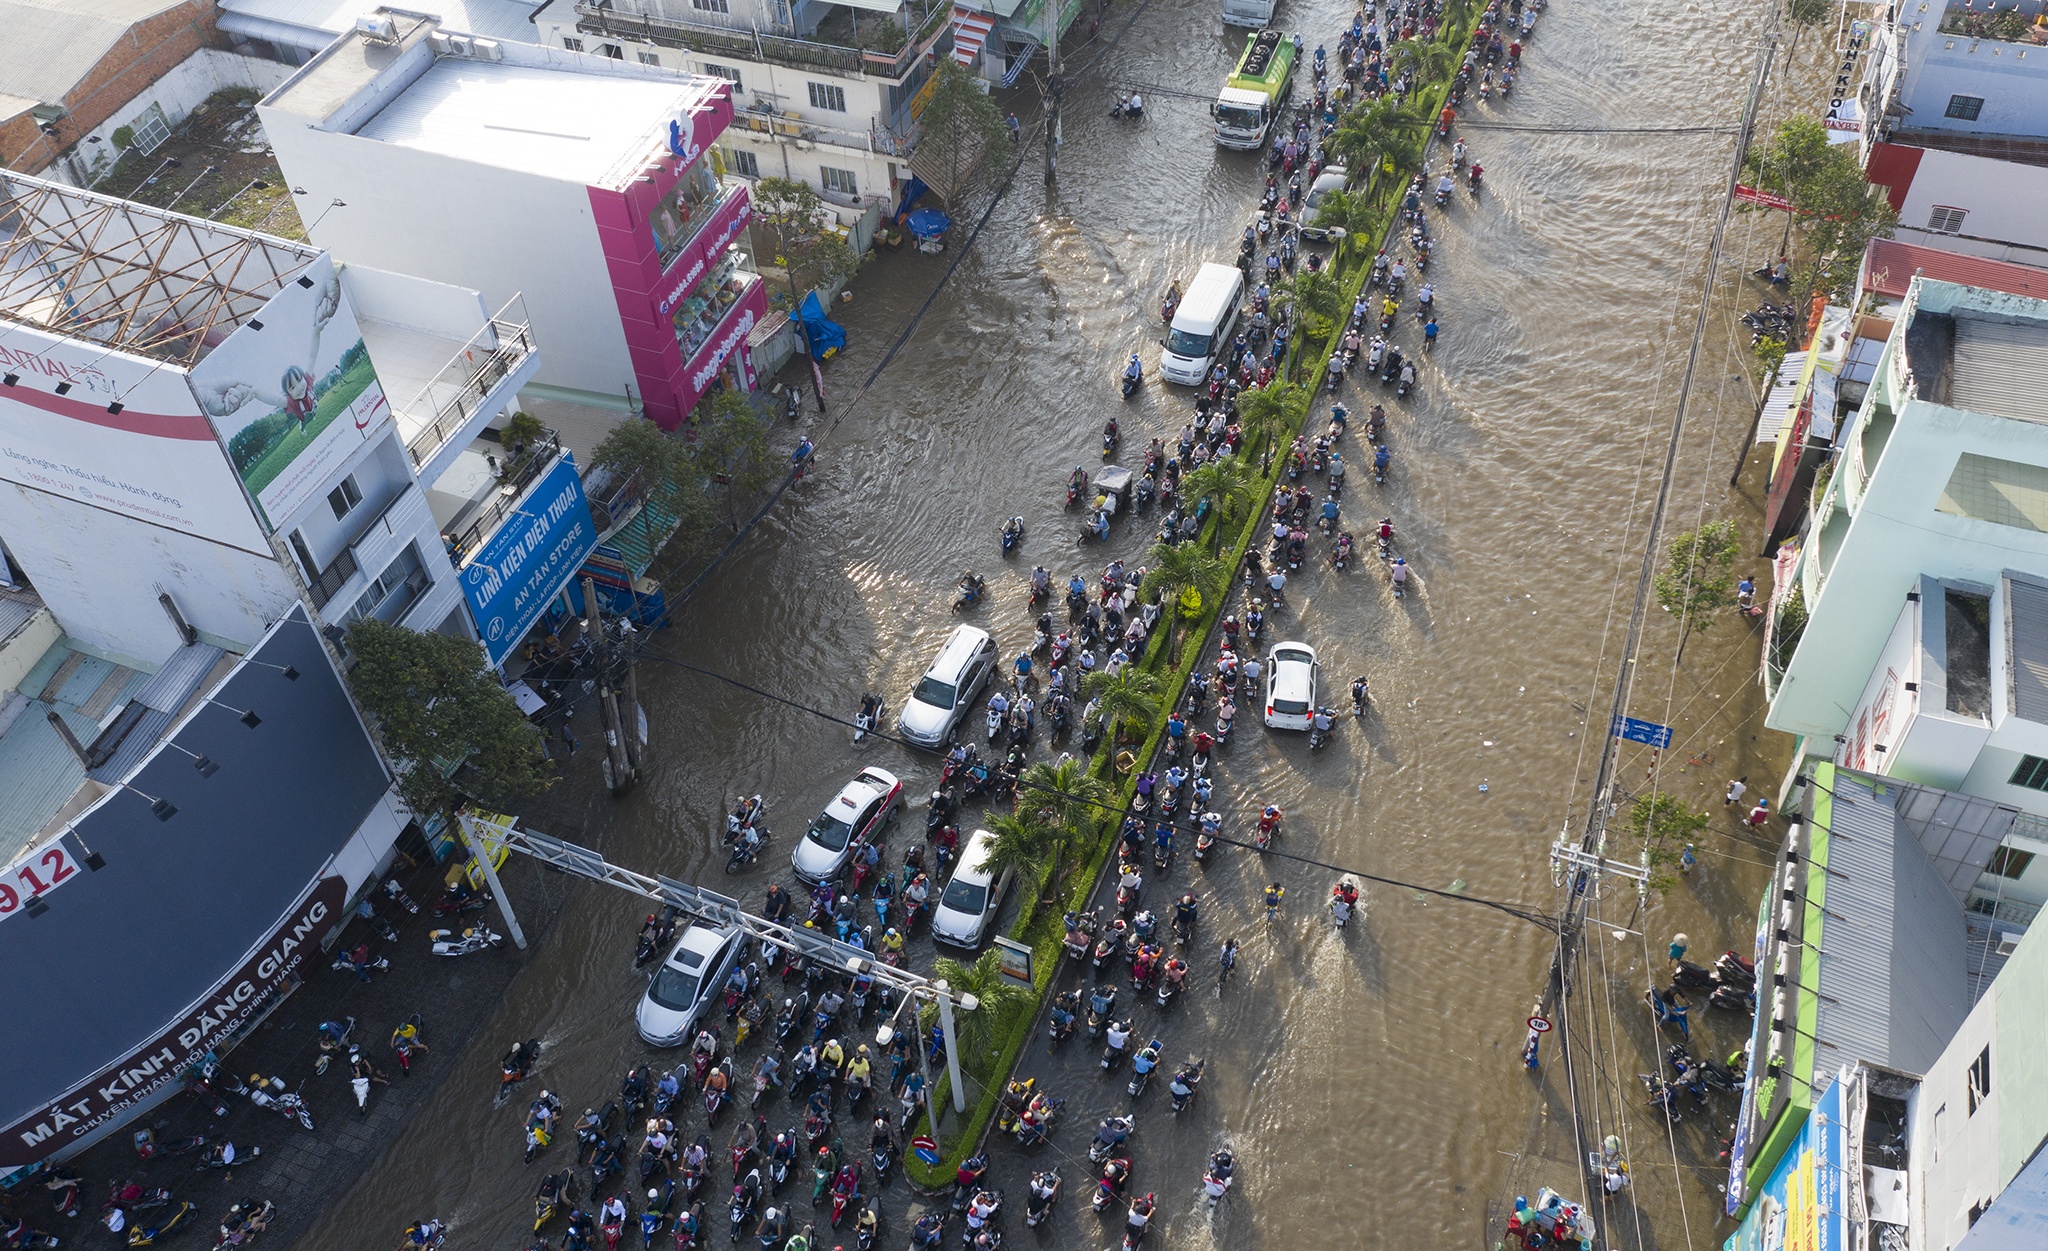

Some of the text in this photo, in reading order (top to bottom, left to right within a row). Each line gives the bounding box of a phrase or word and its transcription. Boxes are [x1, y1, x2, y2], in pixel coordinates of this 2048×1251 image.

[475, 573, 503, 610] LINH
[502, 541, 527, 582] KIỆN
[525, 517, 550, 553] ĐIỆN
[548, 481, 578, 525] THOẠI
[514, 522, 583, 611] AN TÂN STORE
[20, 1098, 90, 1148] MẮT
[98, 1046, 176, 1102] KÍNH
[178, 980, 256, 1050] ĐĂNG
[257, 901, 328, 980] GIANG
[72, 1098, 132, 1136] CHUYÊN
[132, 1071, 172, 1100] PHÂN
[173, 1047, 204, 1074] PHỐI
[204, 1018, 240, 1051] HÀNG
[240, 985, 273, 1018] CHÍNH
